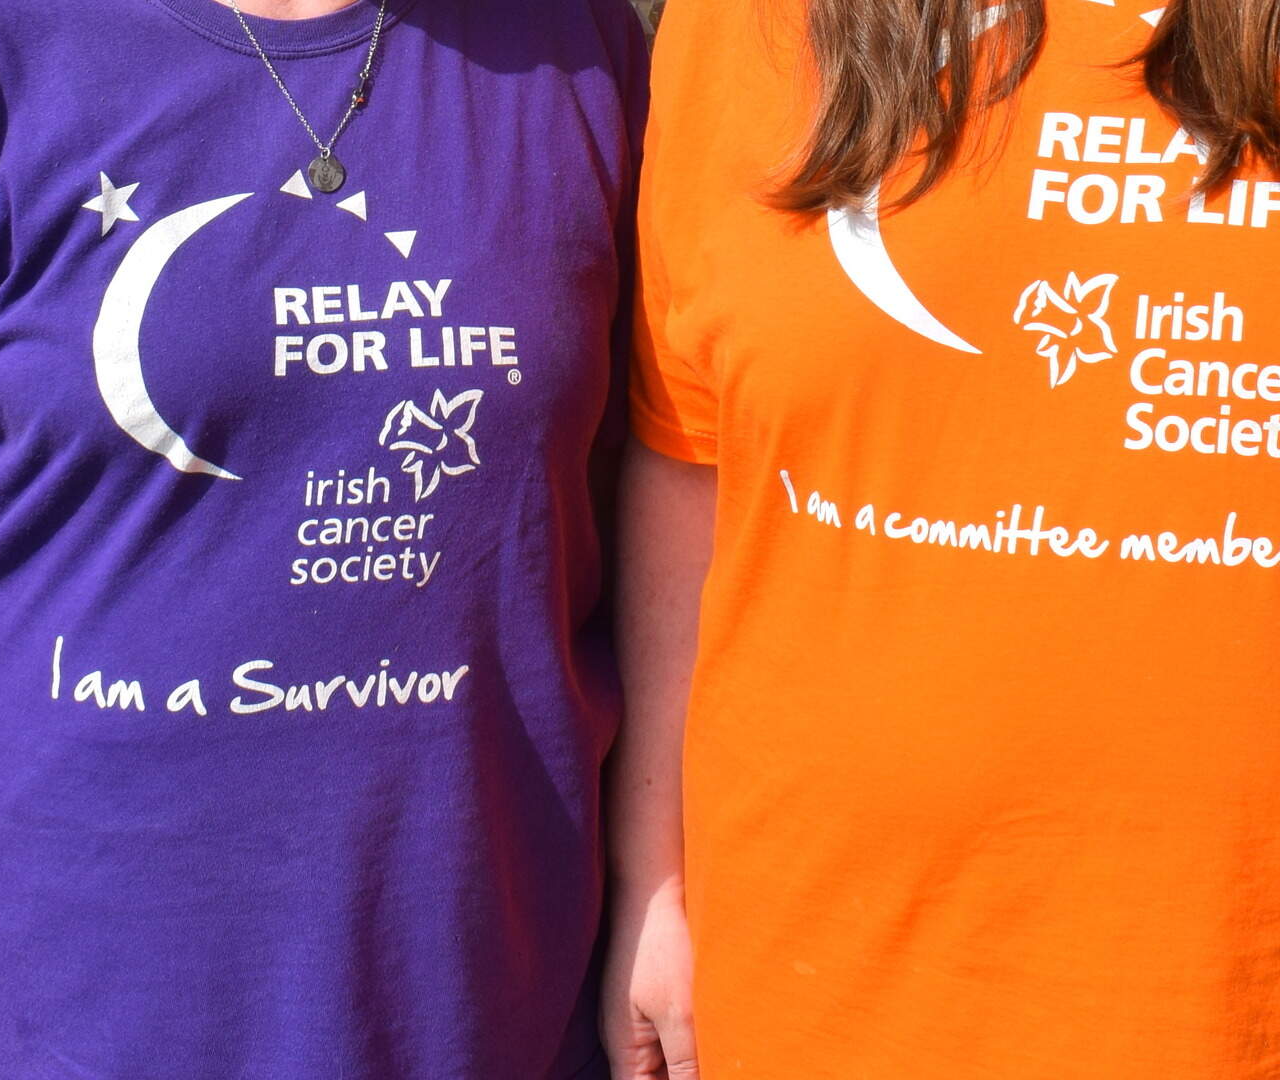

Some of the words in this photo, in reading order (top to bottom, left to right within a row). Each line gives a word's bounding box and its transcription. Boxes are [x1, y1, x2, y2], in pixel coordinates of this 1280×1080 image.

[1037, 112, 1250, 166] RELA
[1027, 168, 1166, 225] FOR
[274, 279, 452, 325] RELAY
[1136, 291, 1244, 342] Irish
[274, 331, 388, 377] FOR
[409, 326, 519, 368] LIFE
[305, 466, 391, 507] irish
[297, 513, 434, 546] cancer
[779, 469, 798, 513] I
[806, 490, 842, 529] am
[854, 503, 876, 536] a
[883, 503, 1110, 559] committee
[290, 545, 442, 587] society
[51, 635, 64, 700] I
[73, 670, 146, 712] am
[166, 678, 208, 716] a
[229, 659, 469, 714] Survivor
